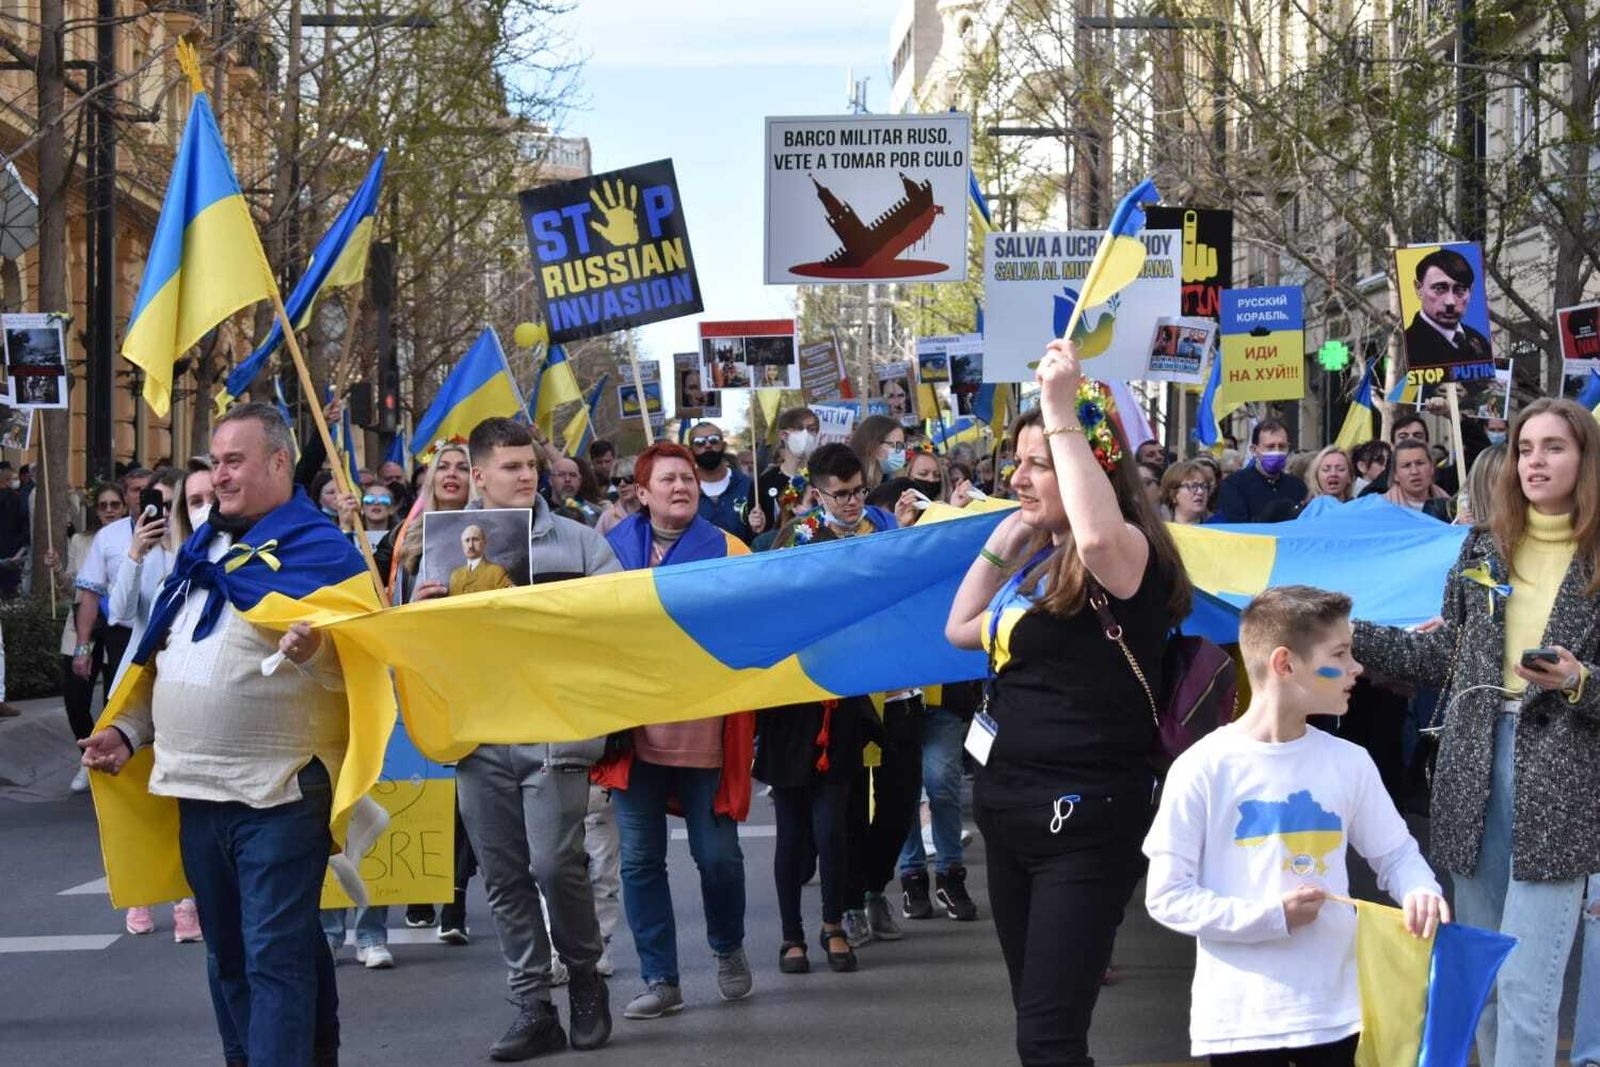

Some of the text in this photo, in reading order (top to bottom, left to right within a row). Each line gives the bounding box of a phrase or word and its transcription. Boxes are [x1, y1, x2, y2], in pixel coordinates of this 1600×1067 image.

[784, 127, 952, 147] BARCO MILITAR RUSO,
[774, 150, 963, 170] VETE A TOMAR POR CULO
[994, 235, 1047, 258] SALVA
[1050, 235, 1062, 257] A
[1141, 234, 1173, 255] HOY
[541, 237, 687, 298] RUSSIAN
[994, 261, 1040, 281] SALVA
[1042, 260, 1061, 280] AL
[1062, 259, 1093, 280] MUN
[548, 272, 694, 332] INVASION
[1236, 293, 1288, 308] РУССКИЙ
[1245, 345, 1278, 361] ИДИ
[1229, 363, 1299, 382] НА ХУЙ!!!
[1406, 363, 1495, 385] STOP PUTIN
[814, 408, 849, 426] PUTIN
[345, 831, 449, 882] BRE
